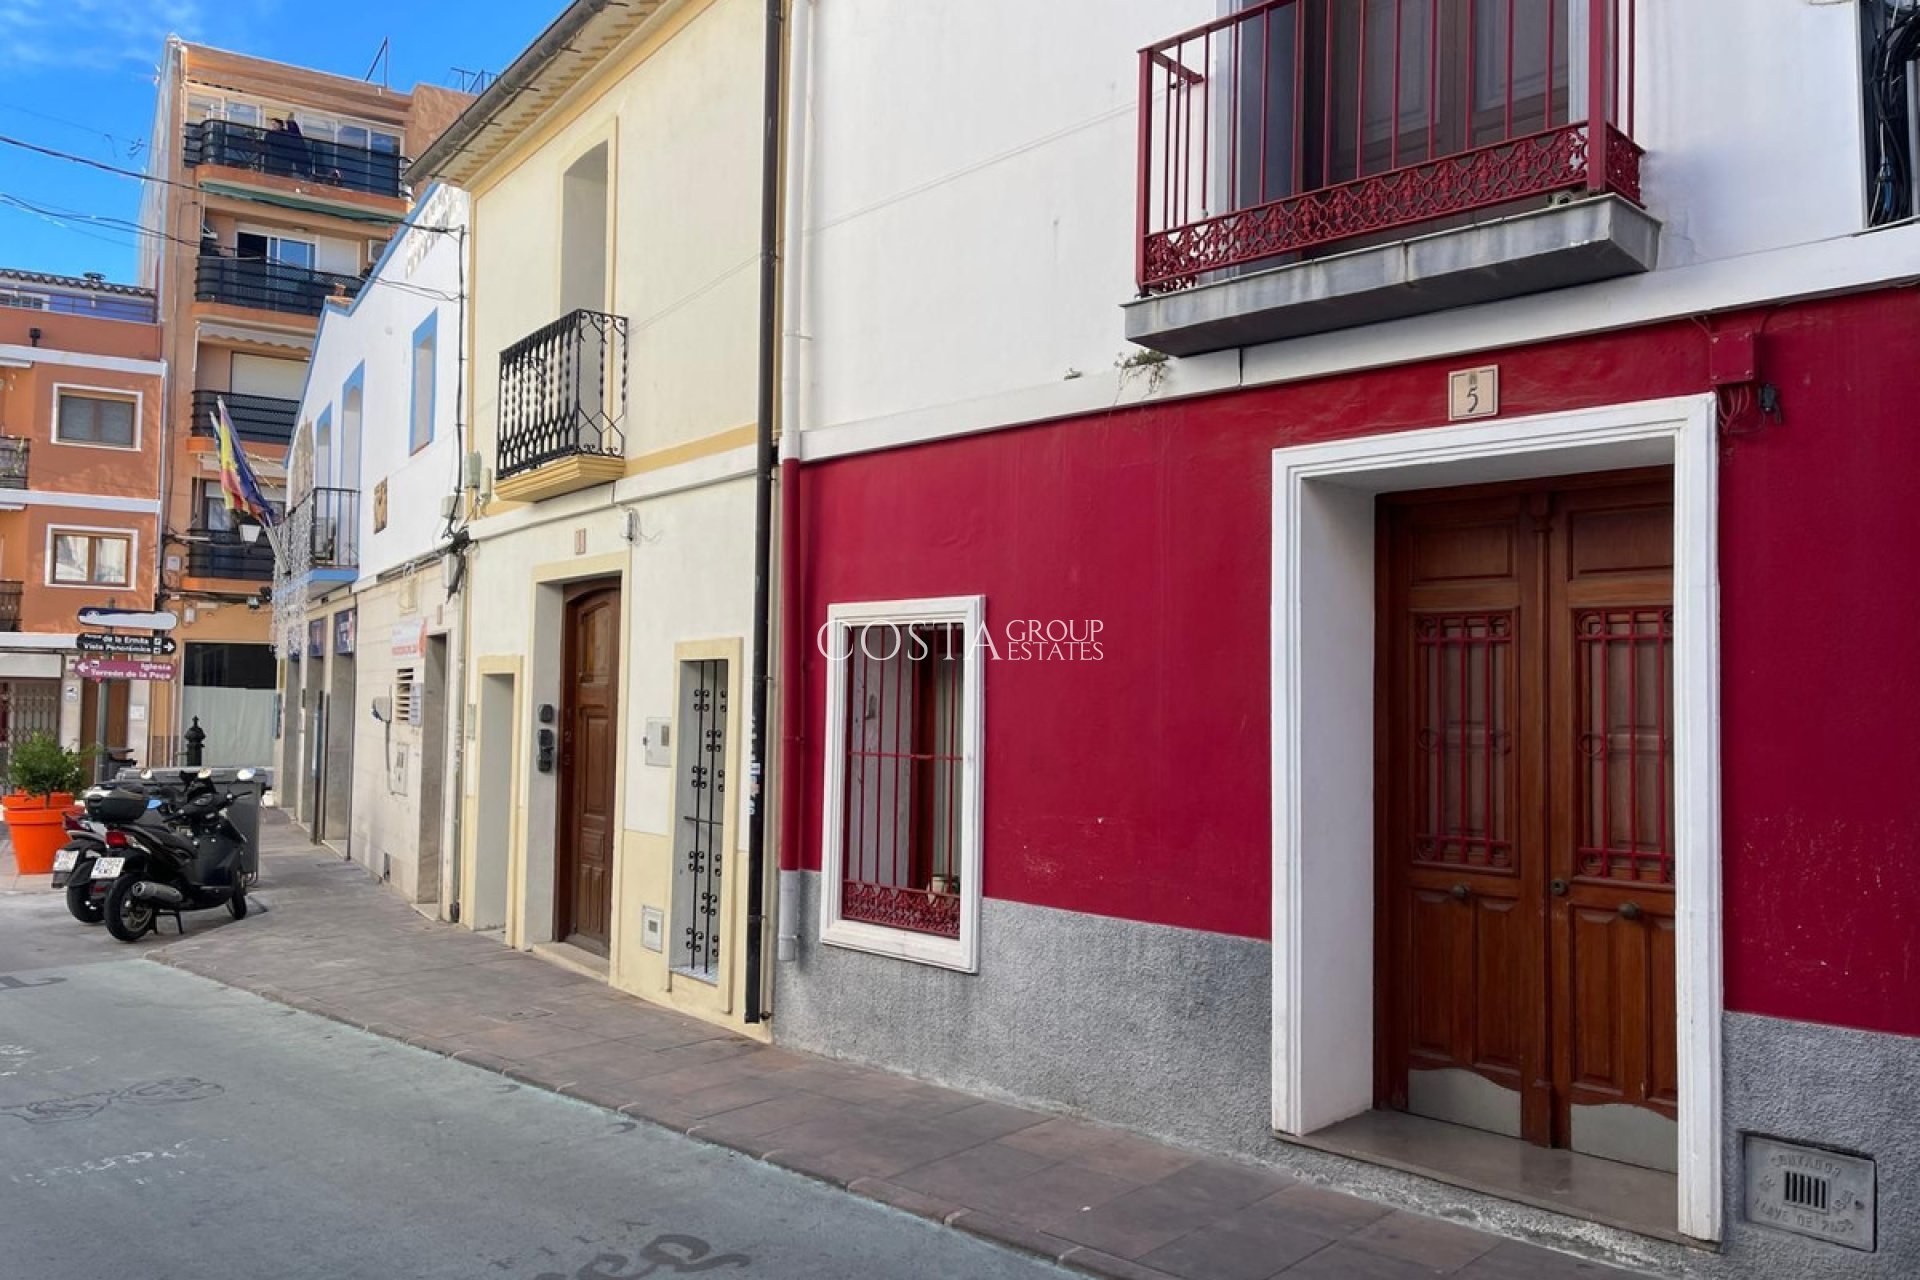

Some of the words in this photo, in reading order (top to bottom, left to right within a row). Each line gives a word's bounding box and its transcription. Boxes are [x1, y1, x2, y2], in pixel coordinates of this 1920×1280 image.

[1466, 386, 1479, 413] 5
[140, 662, 172, 671] Iglesia
[126, 670, 137, 678] de
[1797, 1214, 1813, 1228] DE
